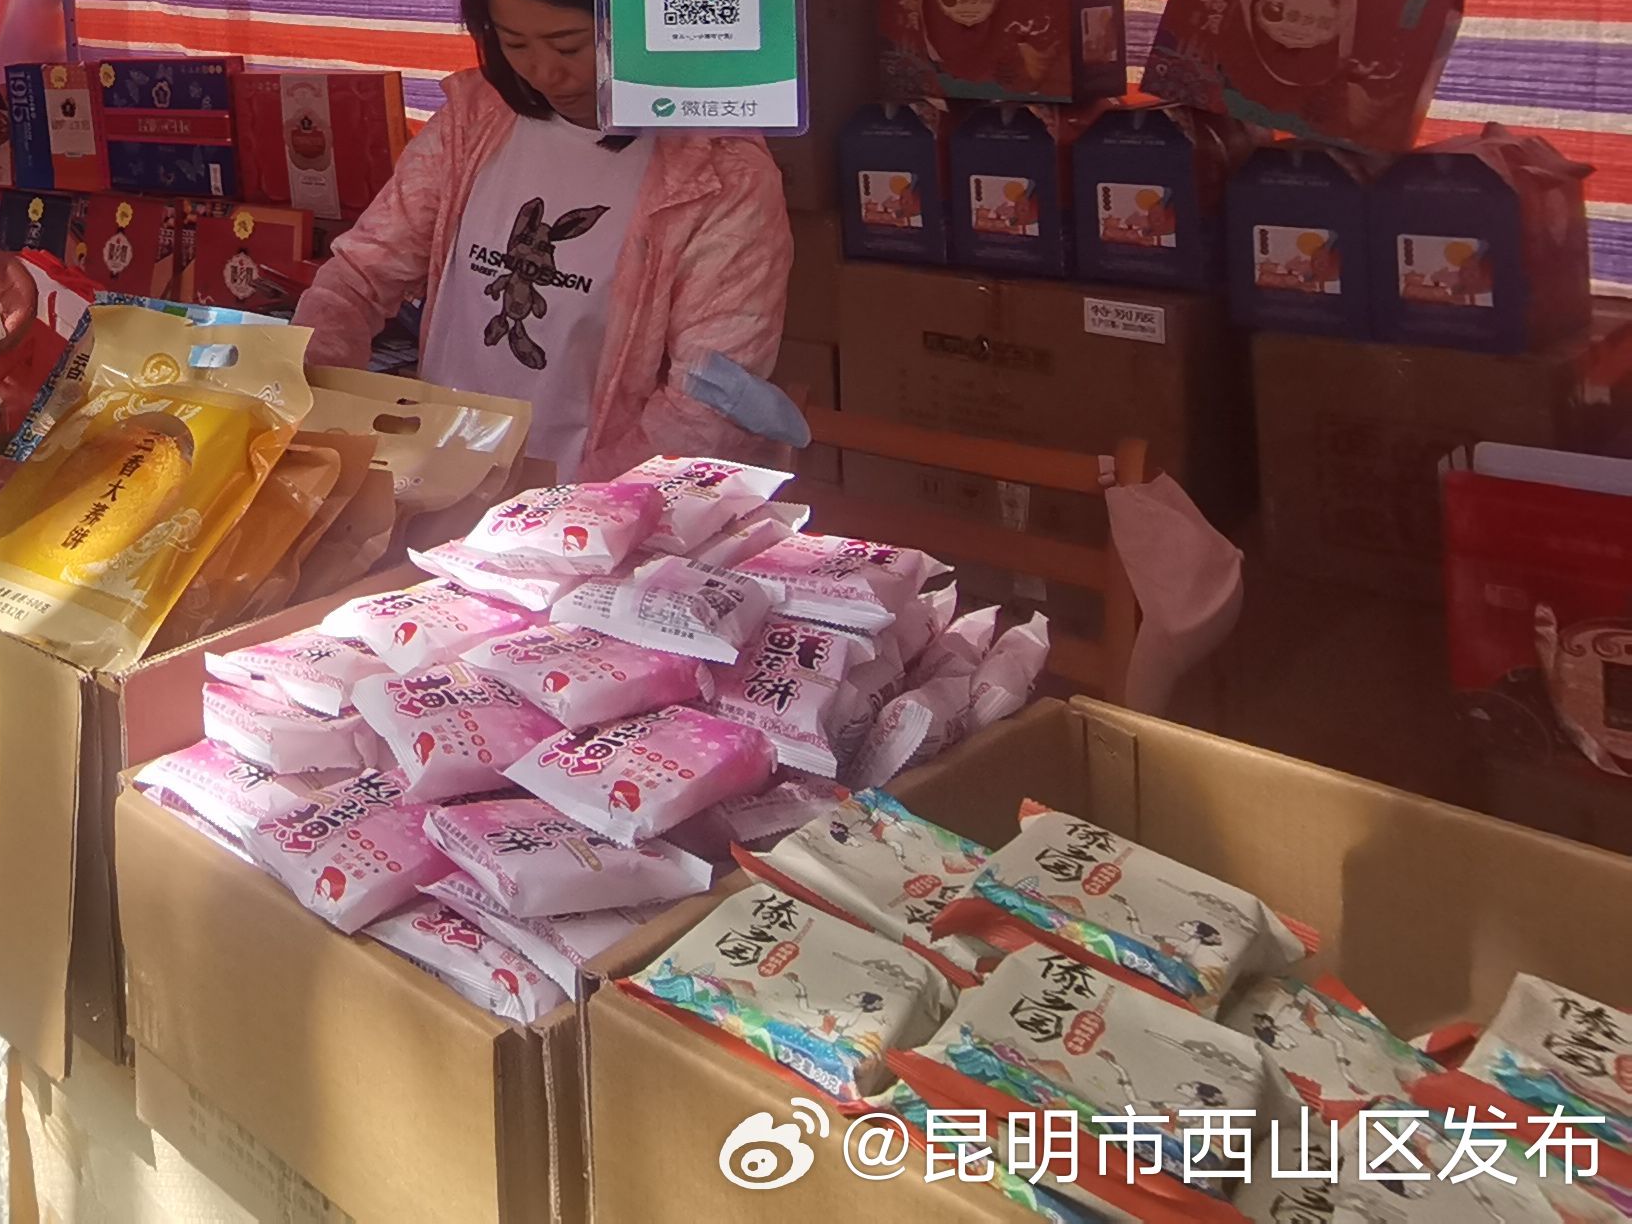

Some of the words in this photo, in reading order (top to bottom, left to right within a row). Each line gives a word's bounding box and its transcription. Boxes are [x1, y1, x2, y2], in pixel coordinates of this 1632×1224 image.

[9, 71, 31, 123] 1915
[681, 100, 758, 117] 微信支付
[745, 623, 833, 714] 鲜花饼
[258, 772, 402, 852] 鲜花饼
